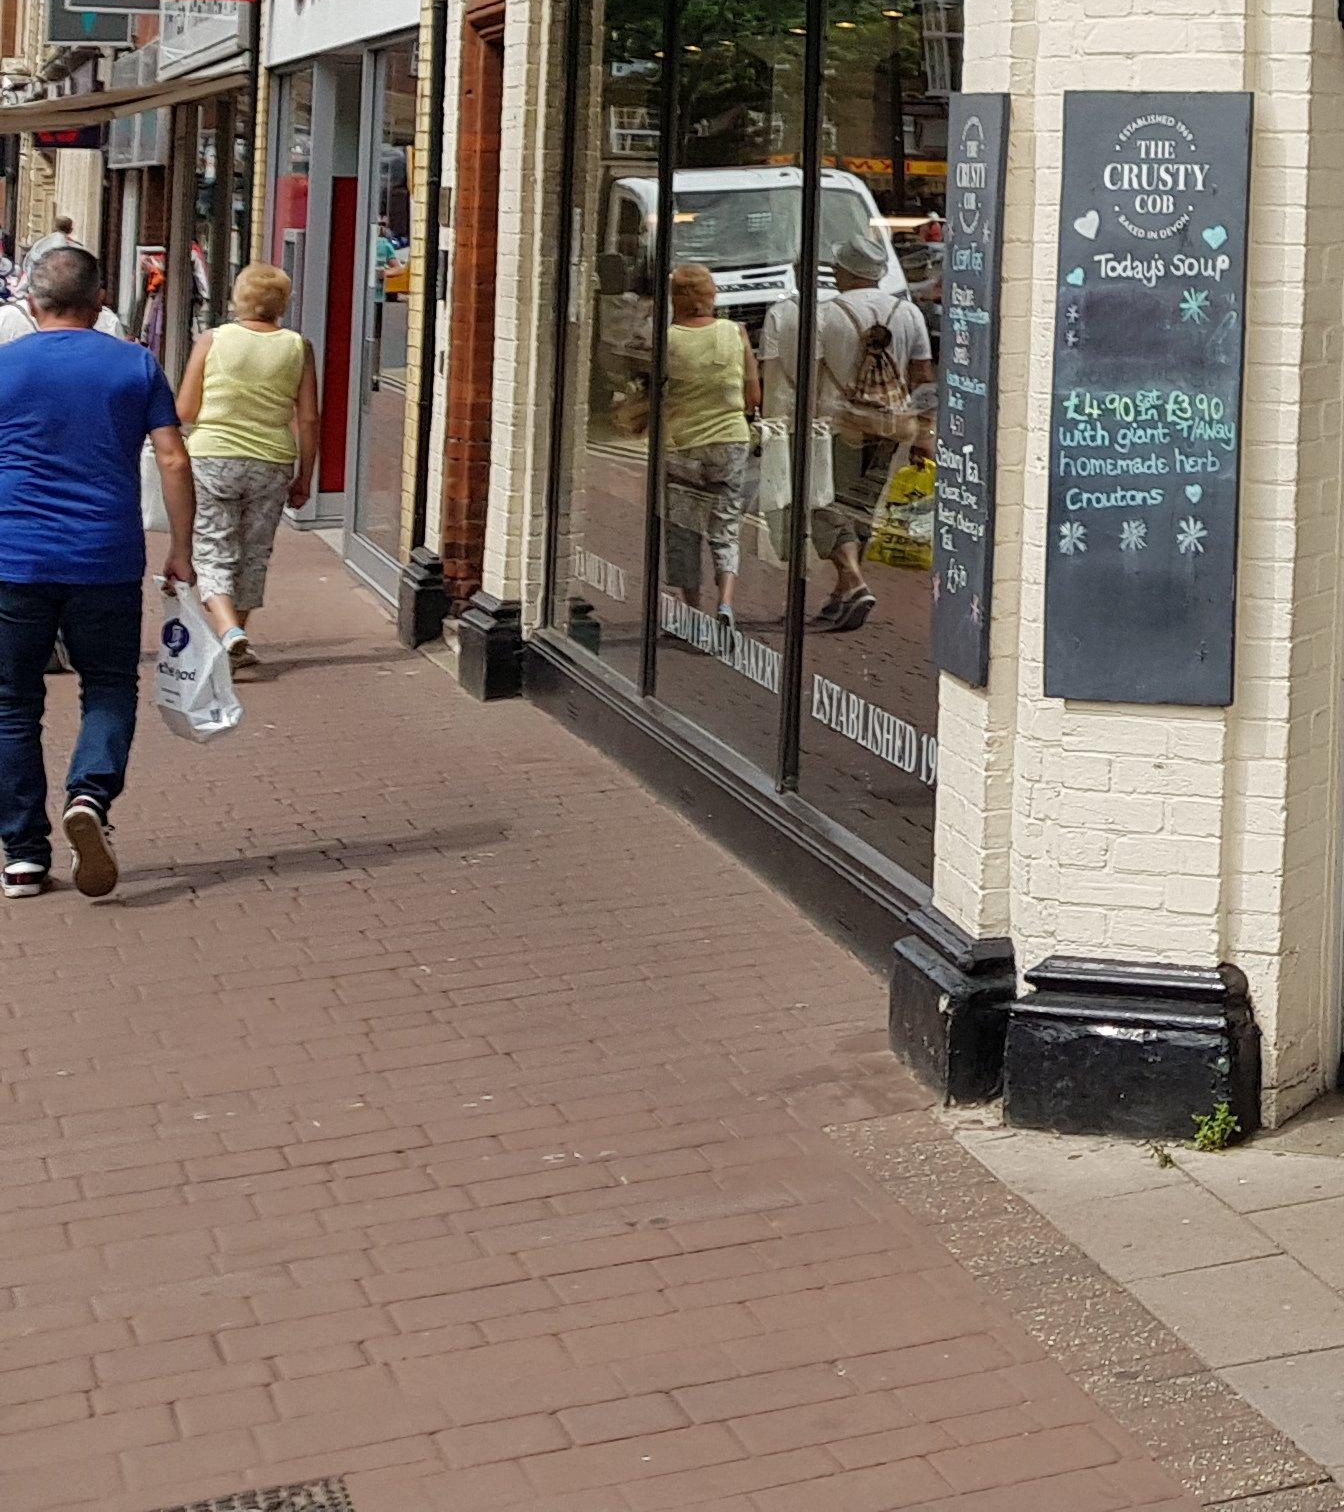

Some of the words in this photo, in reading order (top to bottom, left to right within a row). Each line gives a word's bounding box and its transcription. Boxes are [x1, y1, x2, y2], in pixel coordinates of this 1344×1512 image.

[1137, 140, 1176, 159] THE
[1103, 163, 1210, 190] CRUSTY
[1135, 194, 1175, 214] COB
[1093, 252, 1165, 288] Today's
[1058, 422, 1109, 447] with
[1113, 422, 1171, 454] giant
[1059, 450, 1170, 476] homemade
[1174, 448, 1220, 473] herb
[1066, 486, 1165, 511] Croutons
[733, 630, 784, 694] BAKERY
[811, 673, 917, 774] ESTABLISHED
[918, 734, 938, 786] 19
